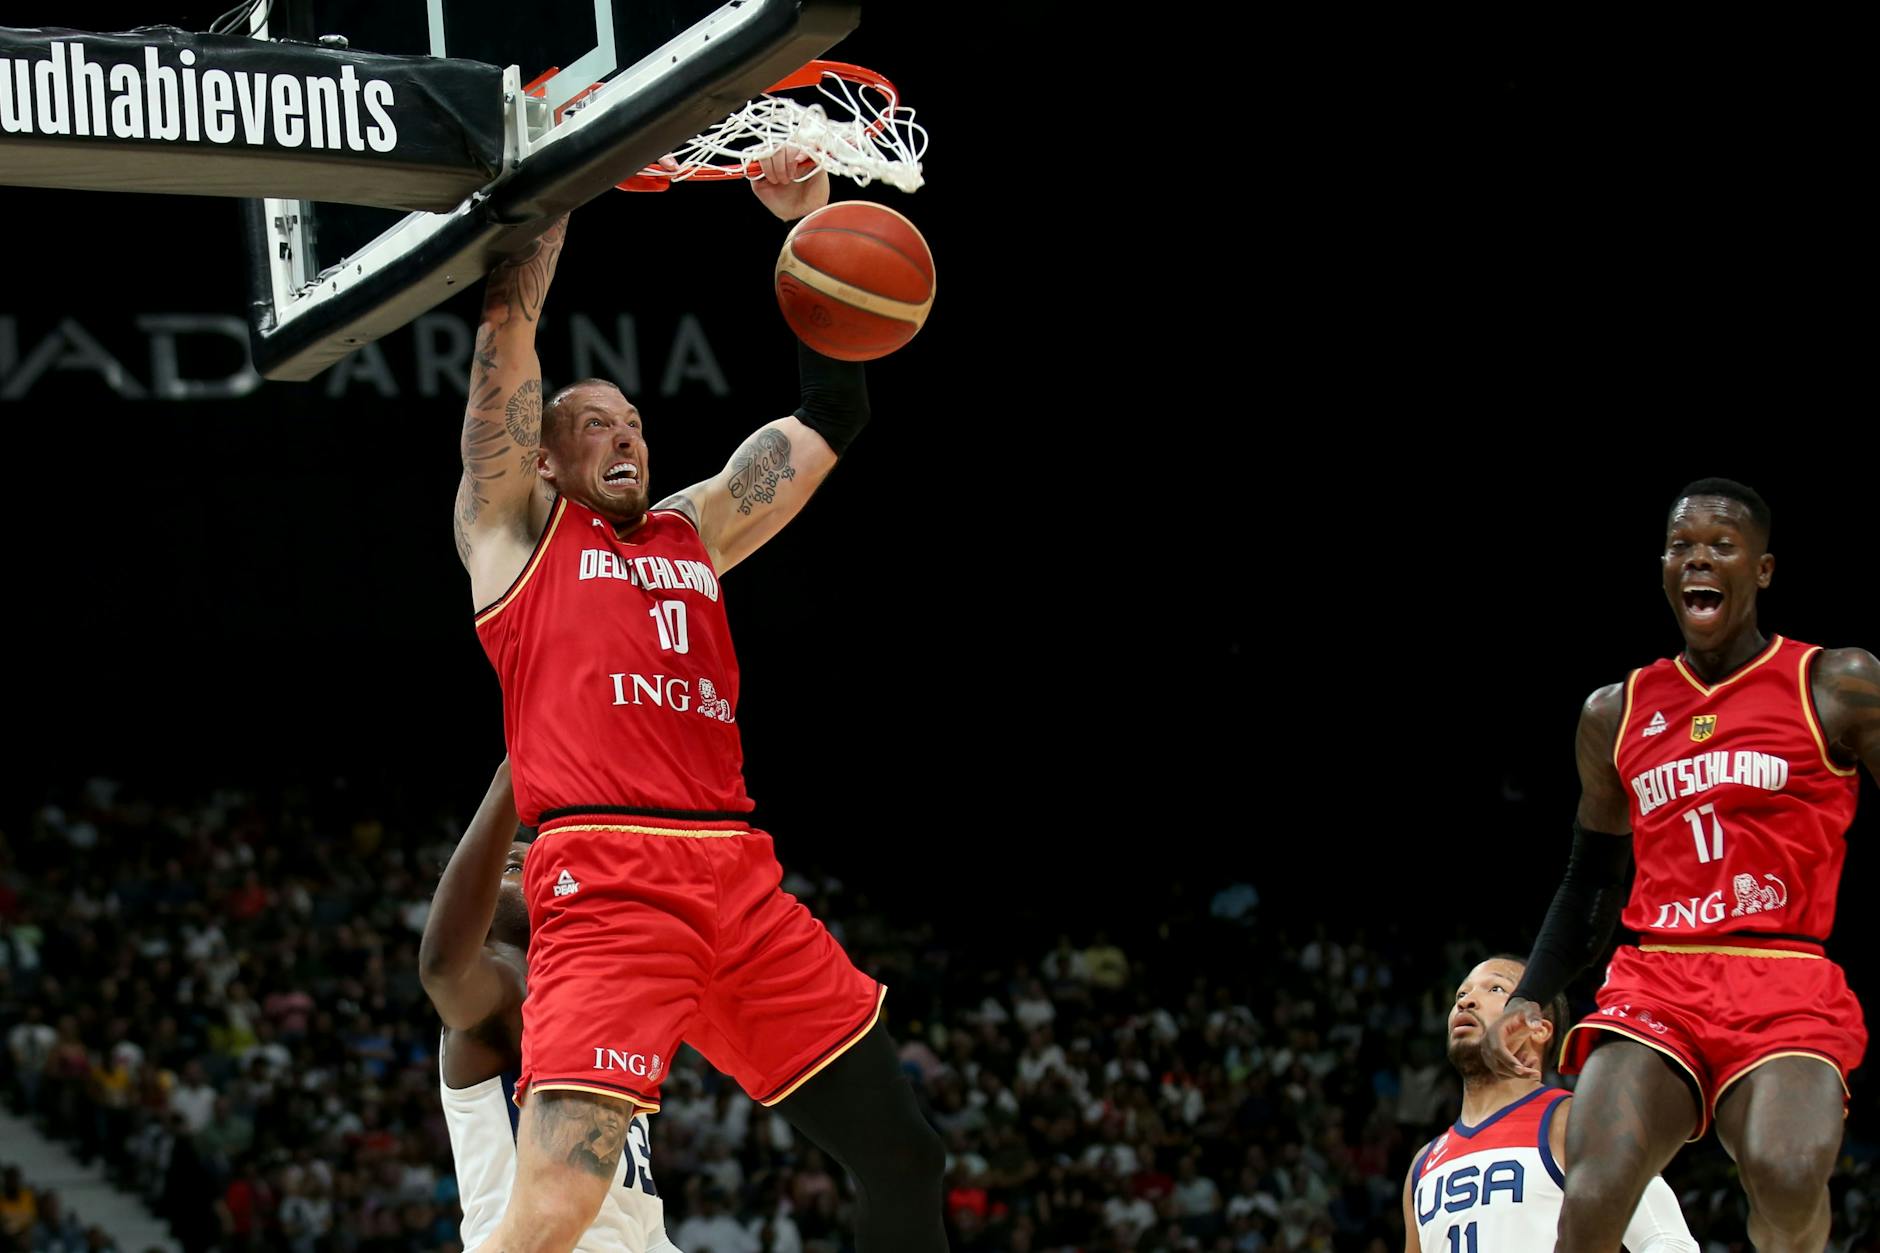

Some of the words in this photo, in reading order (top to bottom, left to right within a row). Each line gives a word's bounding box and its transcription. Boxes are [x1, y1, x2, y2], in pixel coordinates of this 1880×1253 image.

[0, 42, 397, 152] udhabievents
[325, 313, 731, 397] ARNA
[649, 600, 689, 654] 10
[609, 673, 691, 712] ING
[1631, 751, 1788, 816] DEUTSCHLAND
[1682, 803, 1724, 864] 17
[1649, 890, 1726, 928] ING
[593, 1047, 647, 1076] ING
[1418, 1159, 1525, 1227] USA
[1447, 1221, 1478, 1253] 11
